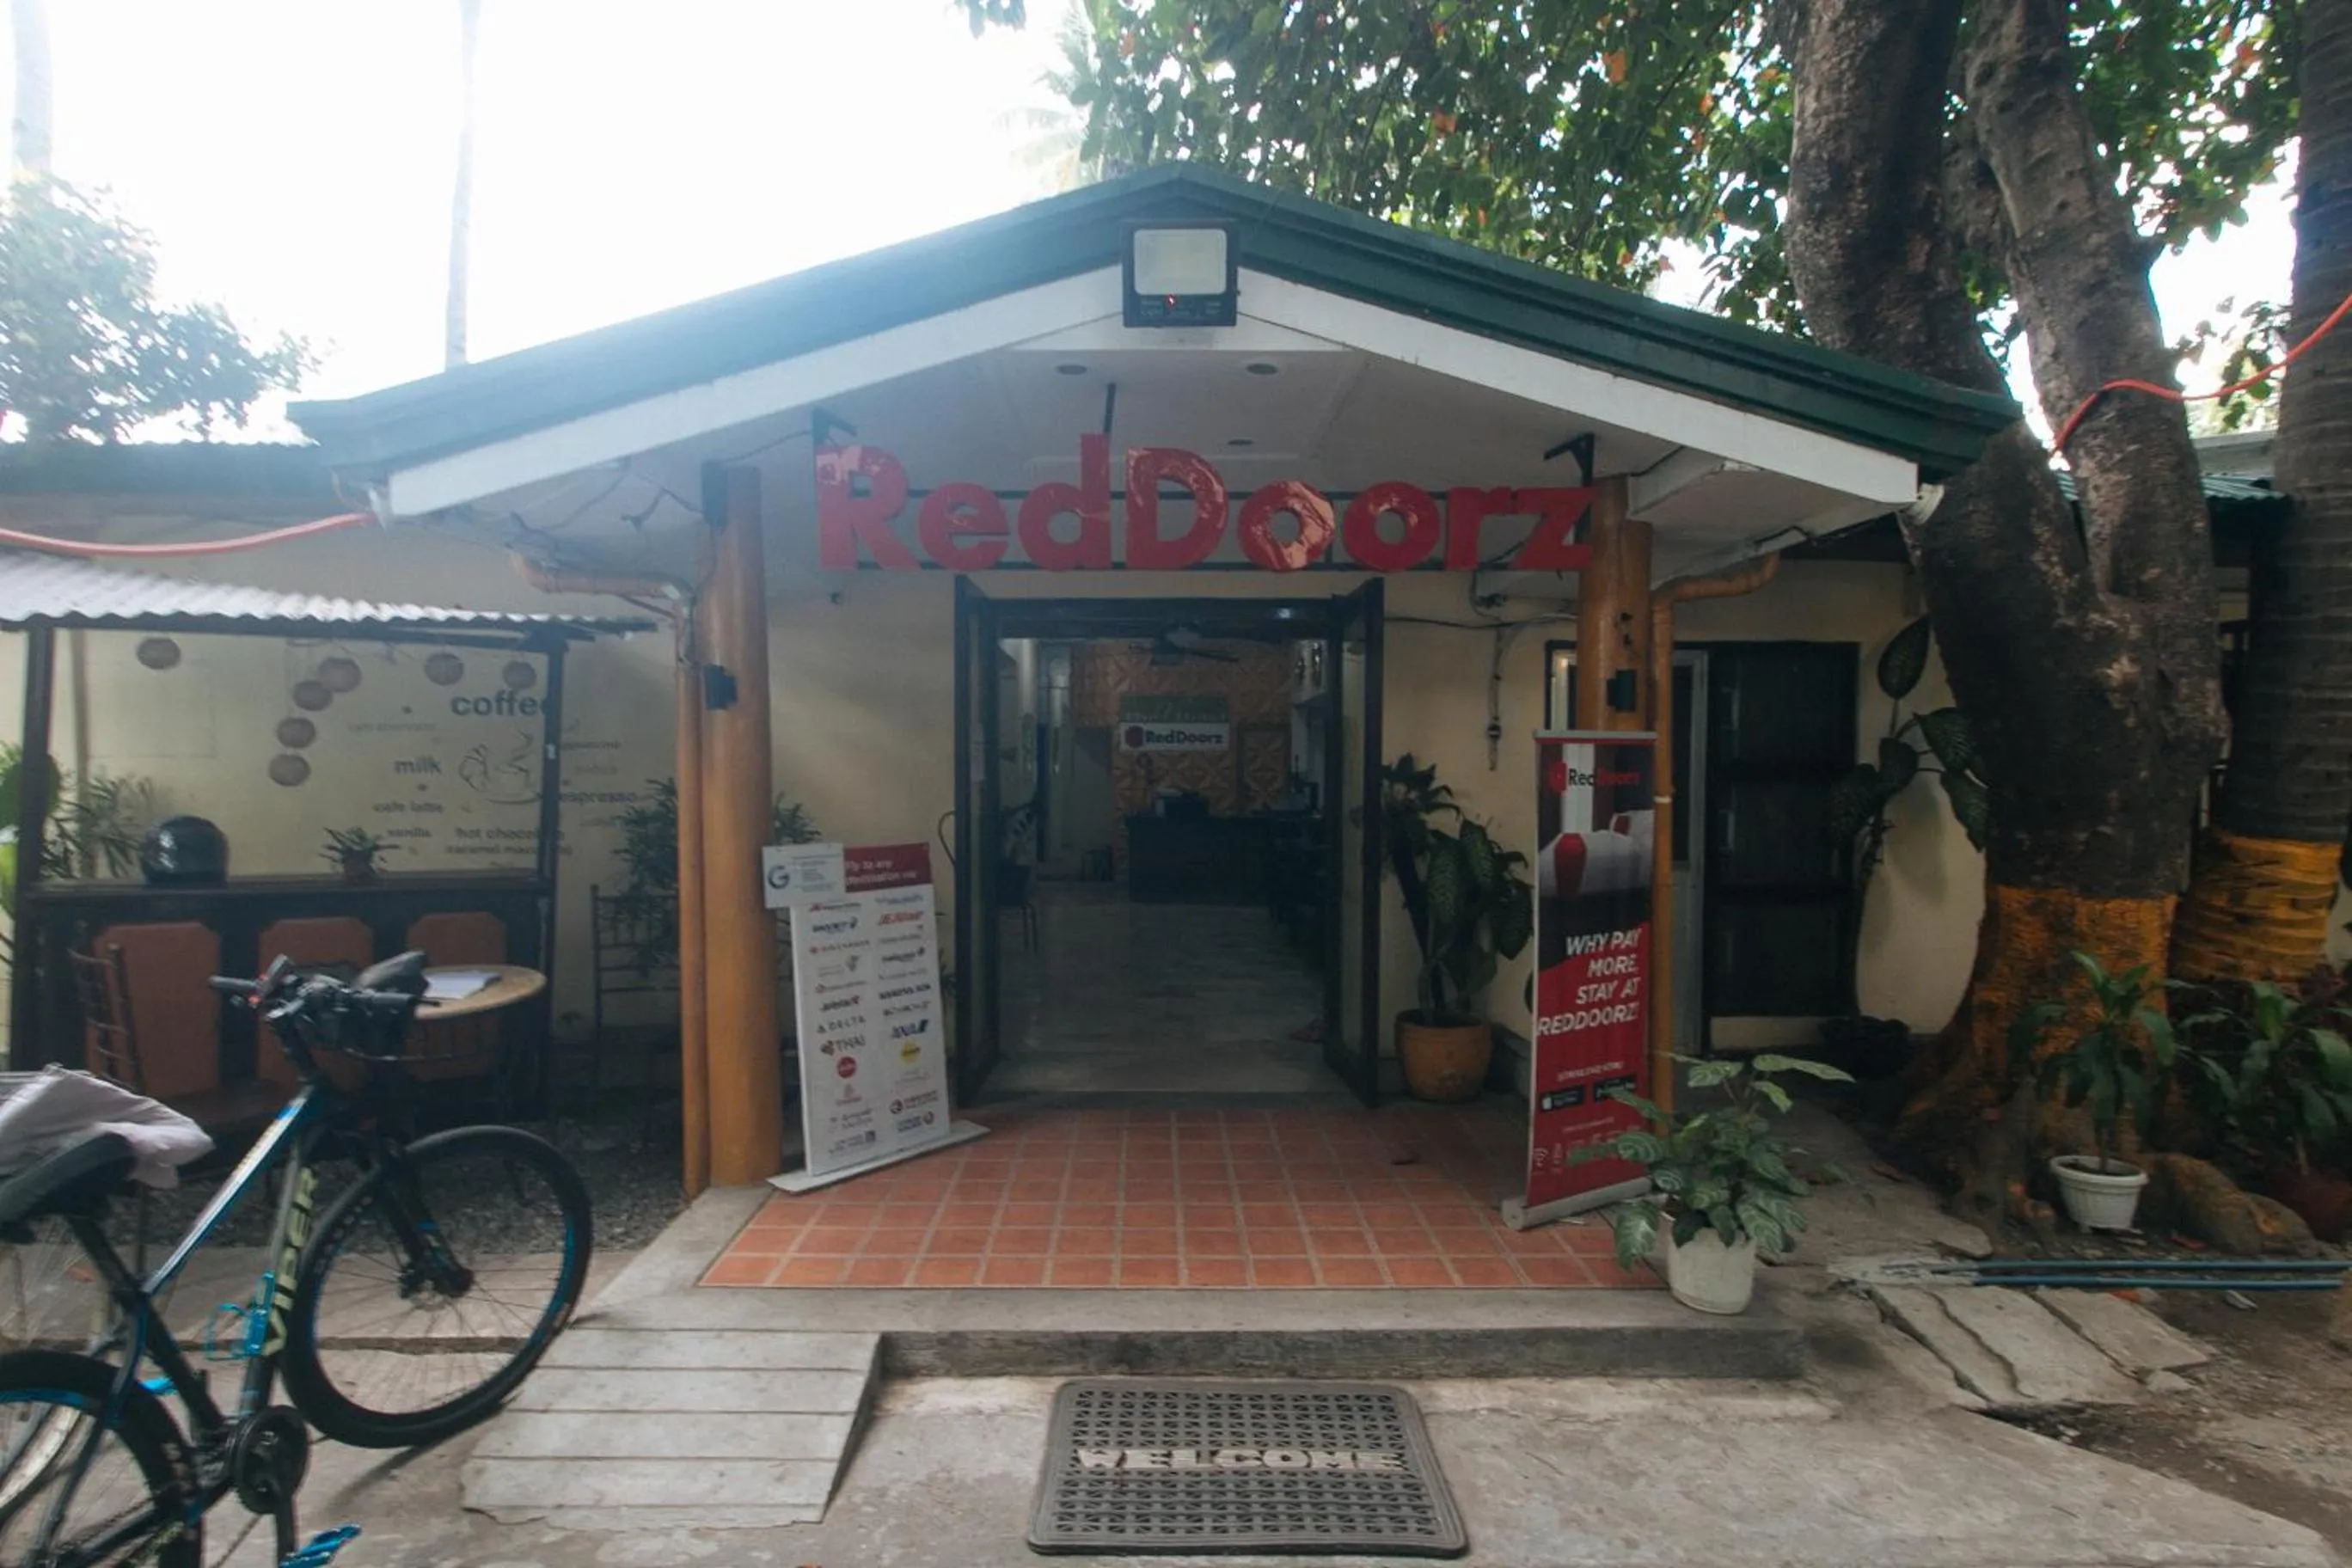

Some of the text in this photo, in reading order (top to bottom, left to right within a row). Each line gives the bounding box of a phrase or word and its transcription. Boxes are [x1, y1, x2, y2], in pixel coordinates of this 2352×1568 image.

[815, 434, 1595, 573] RedDoorz
[450, 689, 552, 716] coffe
[1145, 732, 1224, 744] RedDoorz
[394, 756, 442, 775] milk
[1566, 928, 1642, 955] WHY PAY
[1575, 977, 1641, 1004] STAY AT
[261, 1167, 318, 1357] VIPER
[1076, 1449, 1406, 1470] WELCOME
